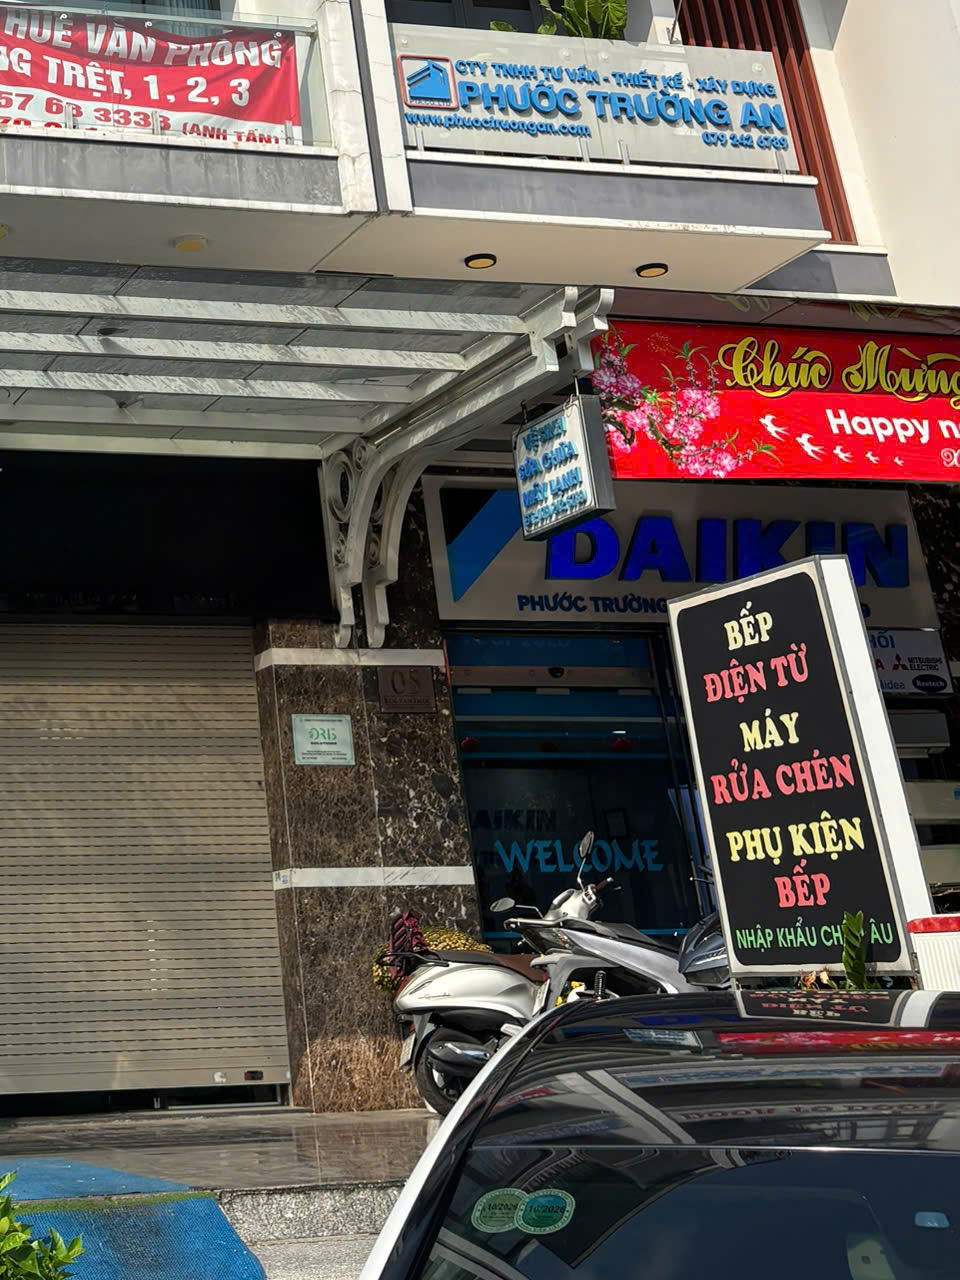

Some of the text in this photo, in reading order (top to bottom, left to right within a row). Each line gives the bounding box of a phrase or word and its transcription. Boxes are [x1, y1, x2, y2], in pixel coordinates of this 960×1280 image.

[230, 78, 251, 107] 3
[455, 59, 486, 77] CTY
[491, 62, 537, 80] TNHH
[540, 64, 563, 82] TƯ
[564, 63, 600, 86] VẤN
[612, 70, 658, 89] THIẾT
[662, 71, 684, 91] KẾ
[696, 75, 728, 94] XÂY
[458, 80, 787, 131] PHƯỚC TRƯỜNG AN
[718, 336, 833, 399] Chúc
[826, 408, 929, 444] Happy
[544, 515, 910, 589] DAIKIN
[517, 592, 669, 614] PHƯỚC TRƯỜNG
[724, 601, 774, 651] BẾP
[704, 643, 809, 703] ĐIỆN TỪ
[740, 708, 800, 752] MÁY
[710, 750, 855, 805] RỬA CHÉN
[494, 839, 665, 873] WELCOME
[727, 811, 865, 866] PHỤ KIỆN
[774, 859, 831, 909] BẾP
[736, 924, 774, 952] NHẬP
[776, 916, 817, 949] KHẨU
[870, 921, 894, 945] ÂU
